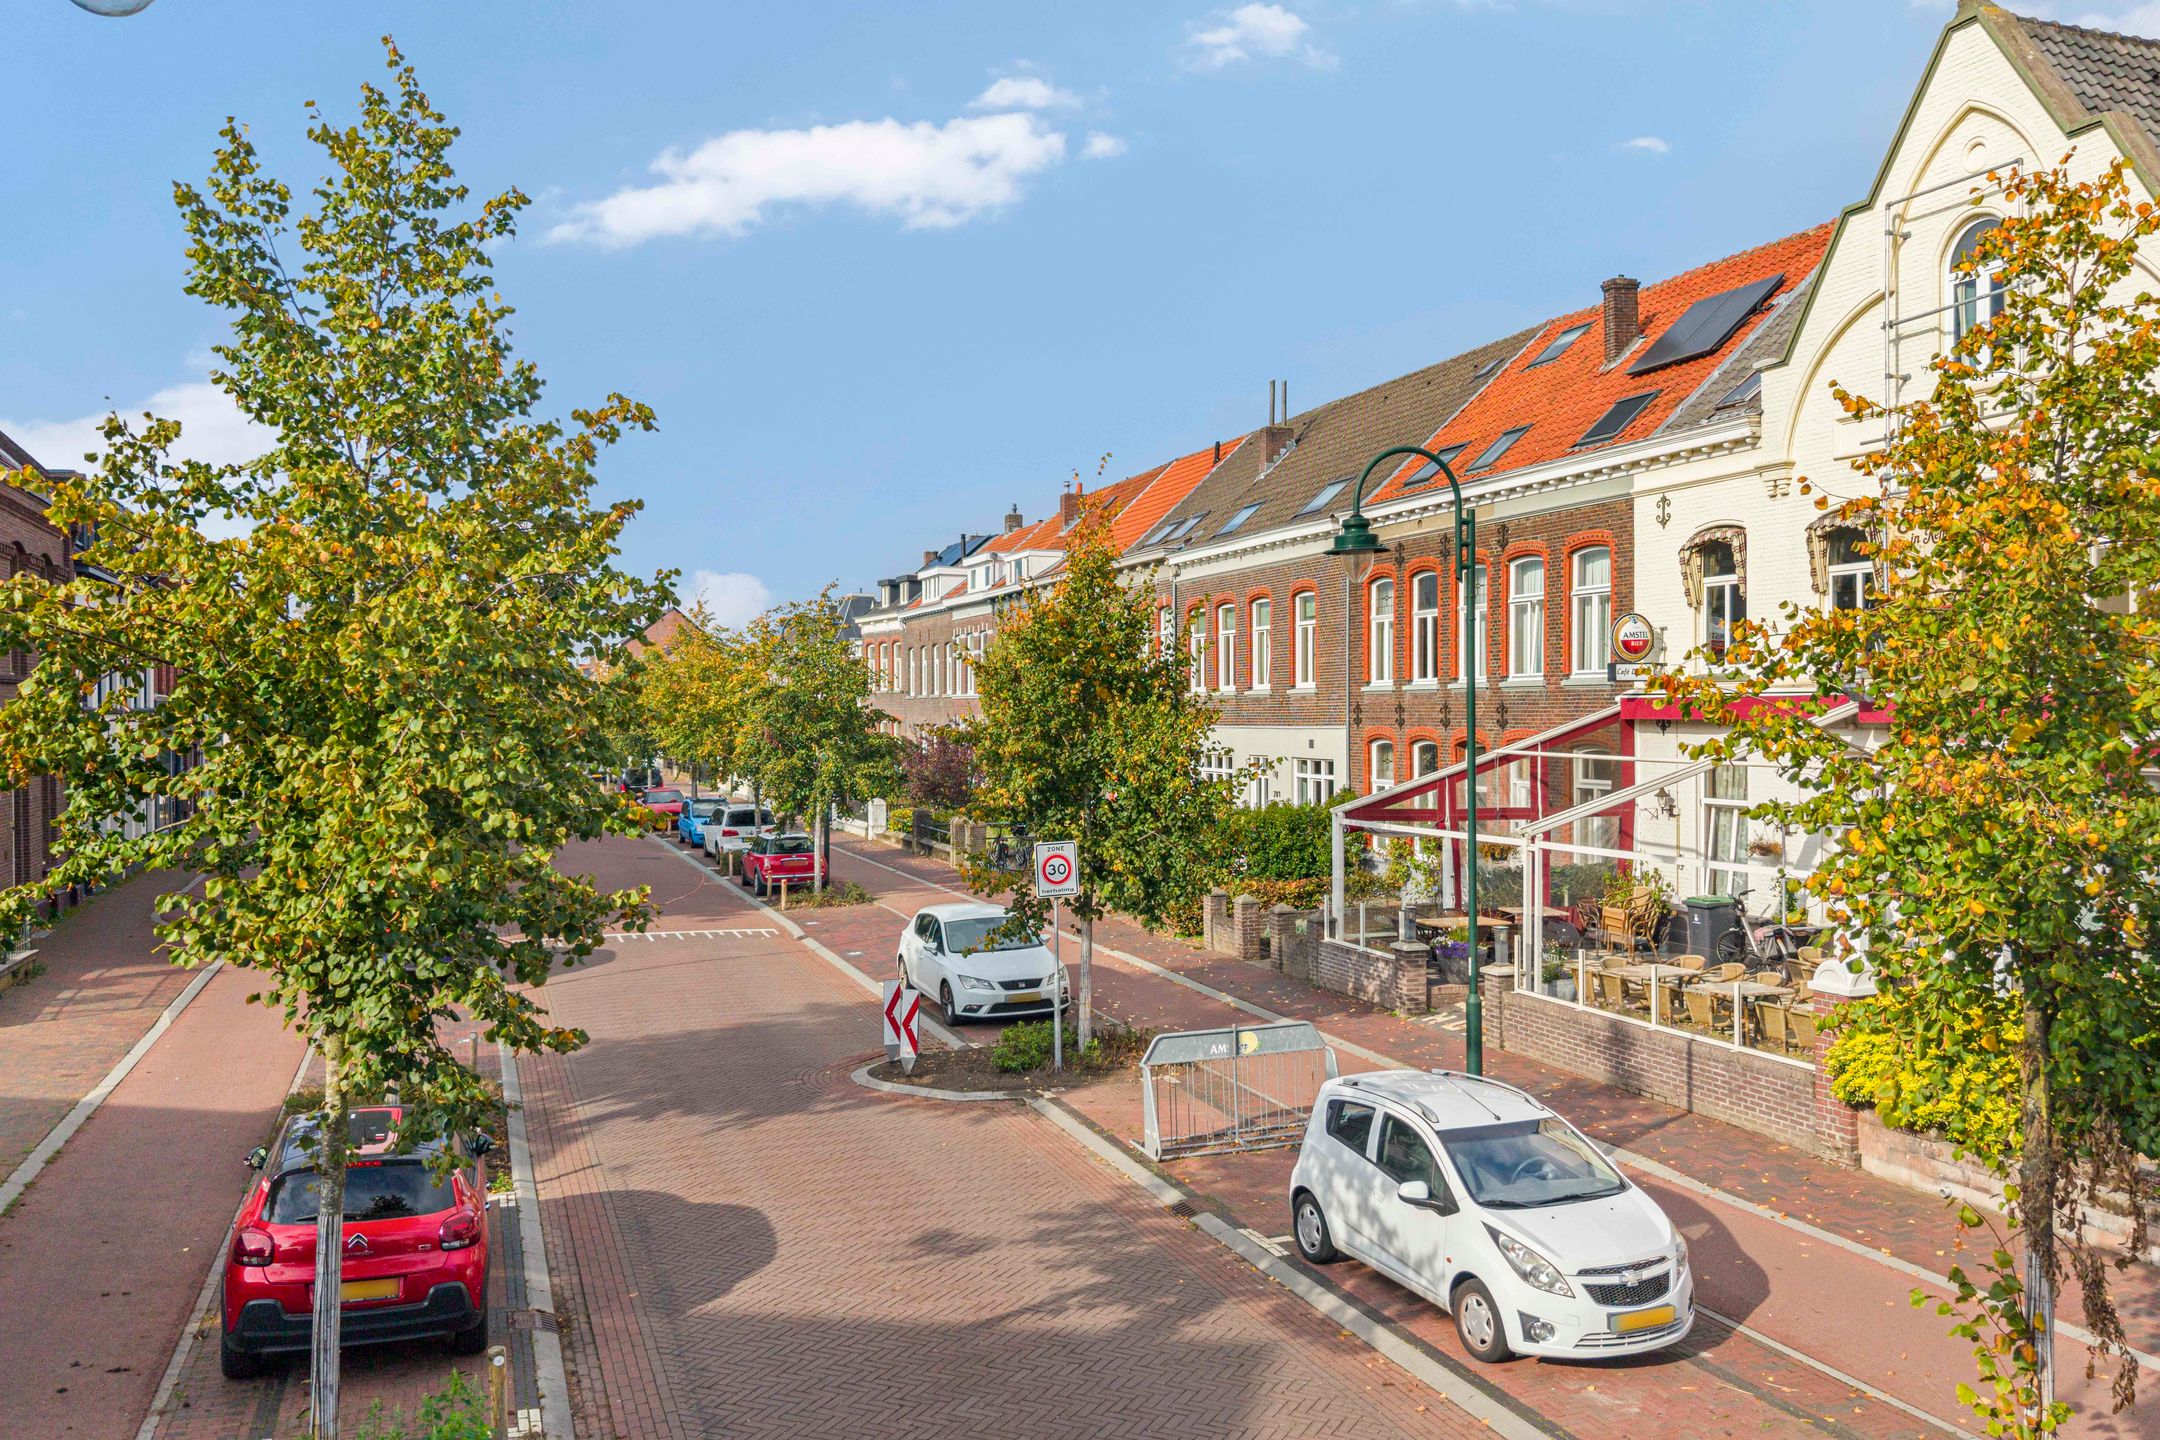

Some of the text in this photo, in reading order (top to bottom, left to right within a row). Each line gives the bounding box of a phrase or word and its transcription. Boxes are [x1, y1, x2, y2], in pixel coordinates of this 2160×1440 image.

[1623, 631, 1648, 639] AMSTEL
[1617, 667, 1630, 676] Café
[1048, 863, 1066, 875] 30
